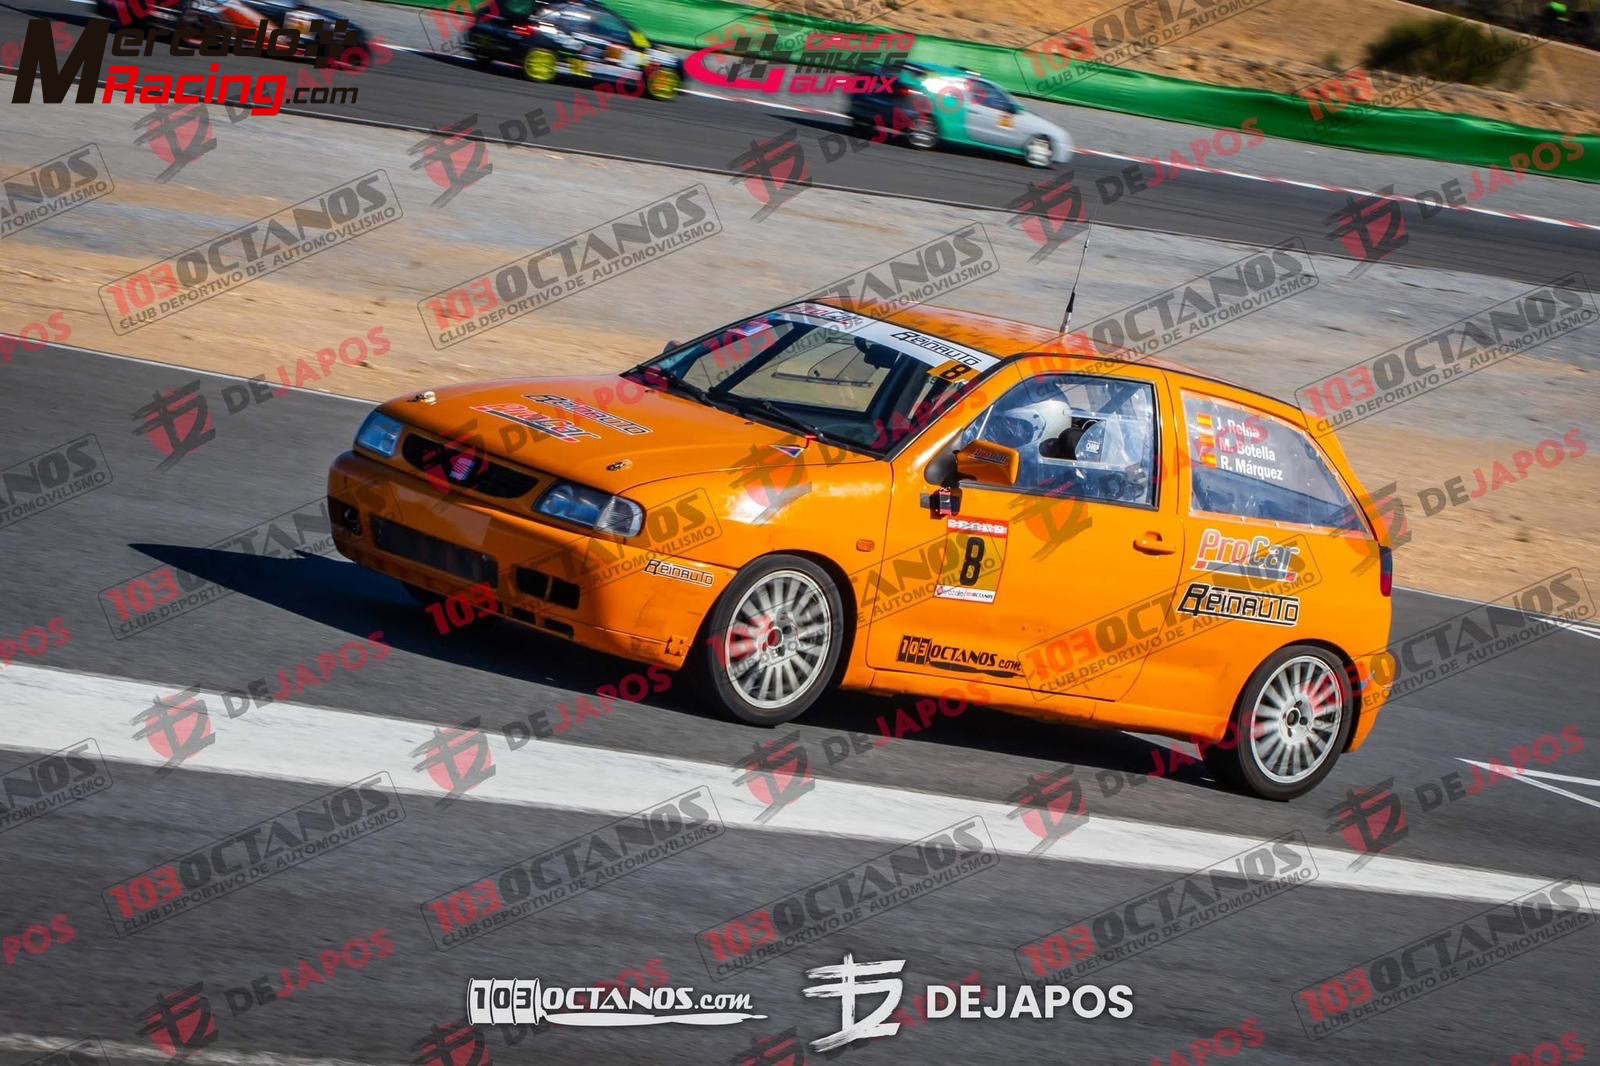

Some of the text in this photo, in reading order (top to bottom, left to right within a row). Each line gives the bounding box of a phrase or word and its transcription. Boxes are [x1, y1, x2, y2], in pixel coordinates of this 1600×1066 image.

[939, 363, 972, 380] 8
[1236, 441, 1276, 461] Botella
[1220, 455, 1284, 481] R. Márquez
[960, 536, 985, 587] 8
[1198, 528, 1301, 571] ProCar
